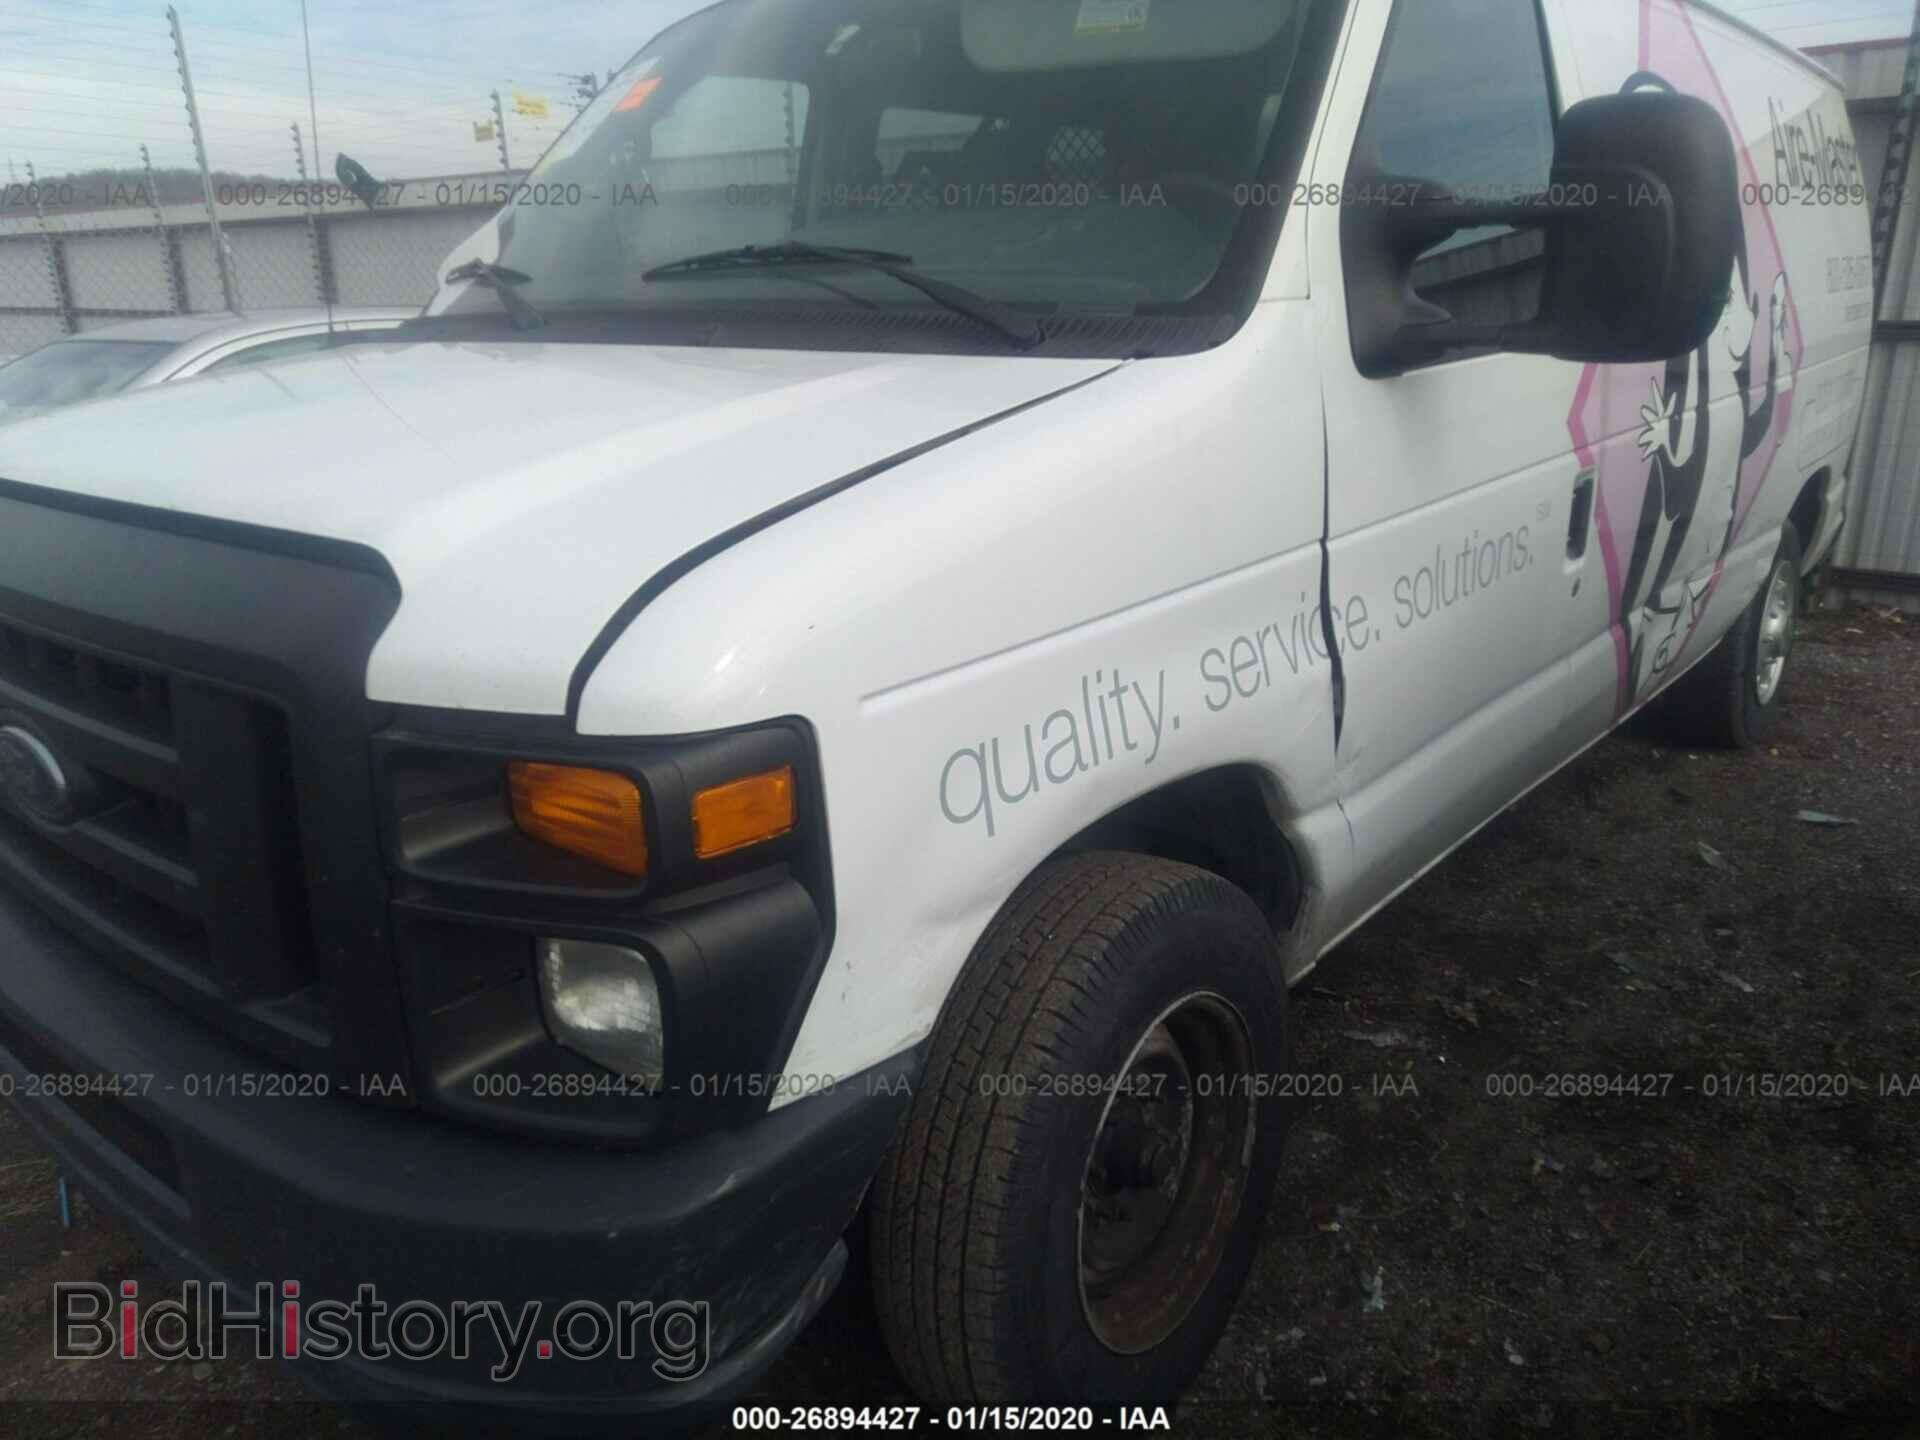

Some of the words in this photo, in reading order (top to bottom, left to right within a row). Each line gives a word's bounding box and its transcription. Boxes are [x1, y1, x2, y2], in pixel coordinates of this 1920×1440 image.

[938, 669, 1180, 837] quality.
[1200, 592, 1381, 712] service.
[1394, 524, 1535, 629] solutions.
